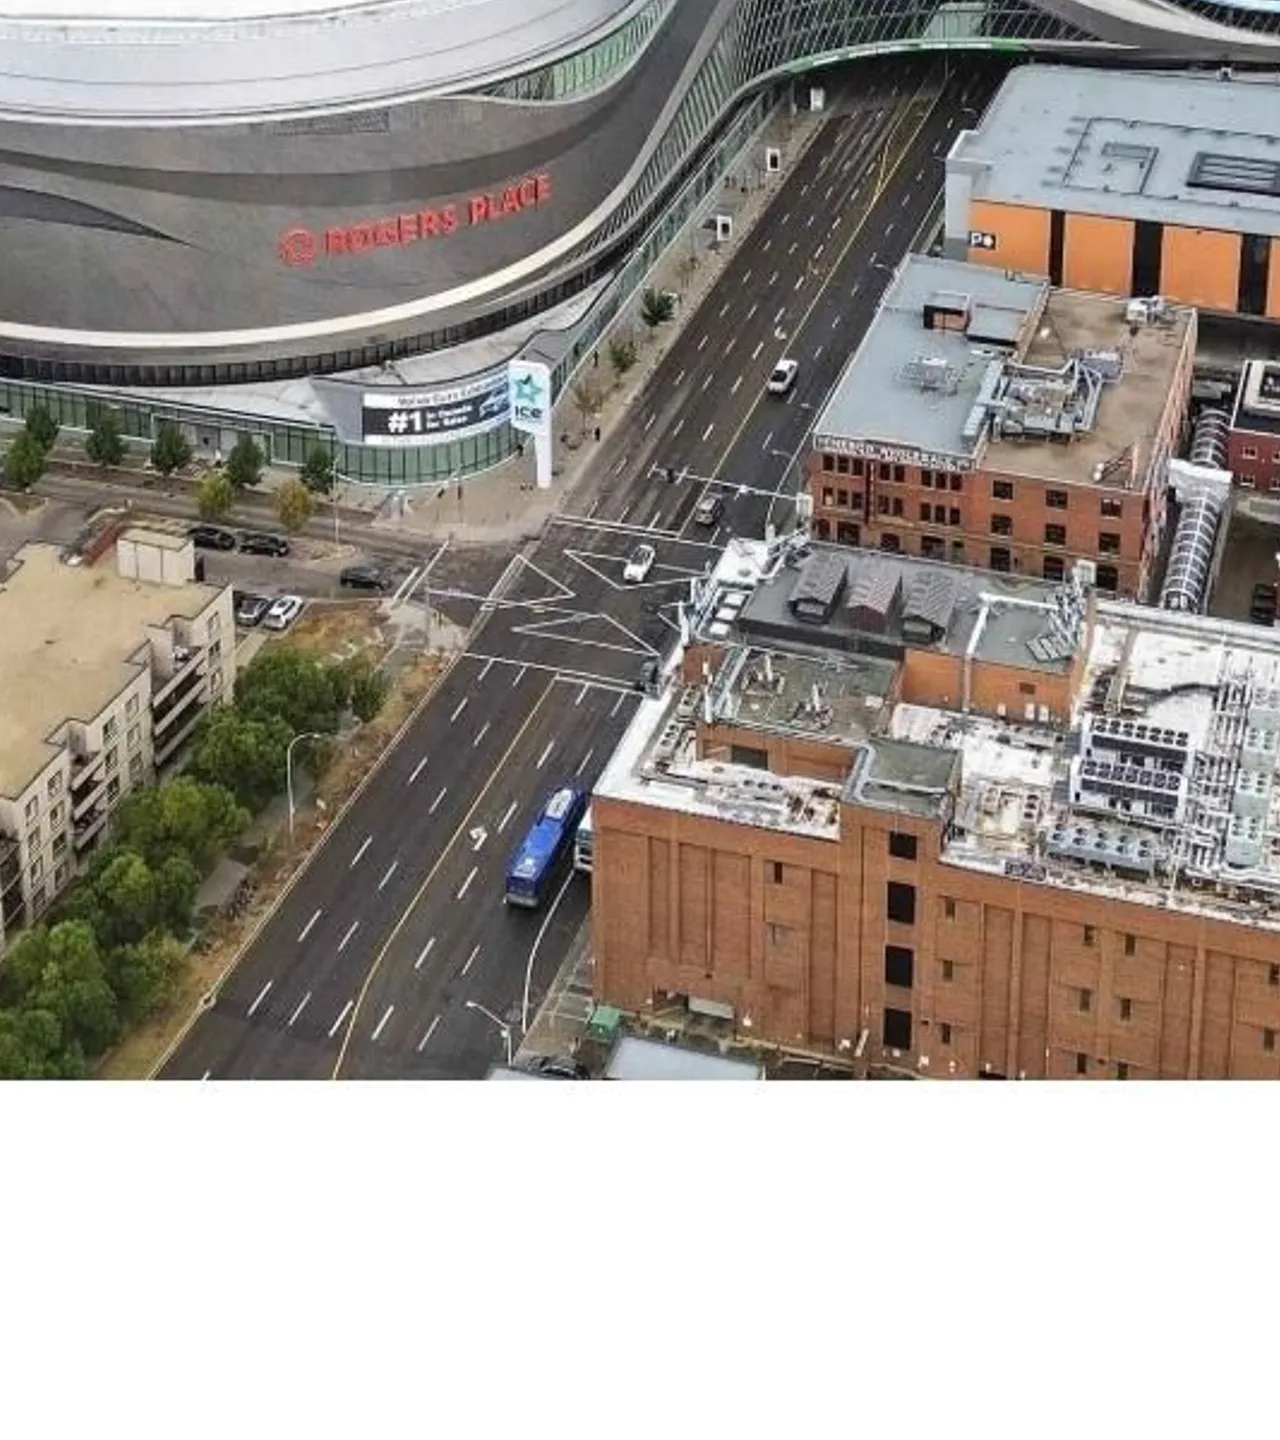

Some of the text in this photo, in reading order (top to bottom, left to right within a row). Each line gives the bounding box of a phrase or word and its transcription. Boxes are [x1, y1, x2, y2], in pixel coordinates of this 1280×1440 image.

[324, 172, 554, 254] ROGERS PLACE
[387, 408, 423, 433] #1
